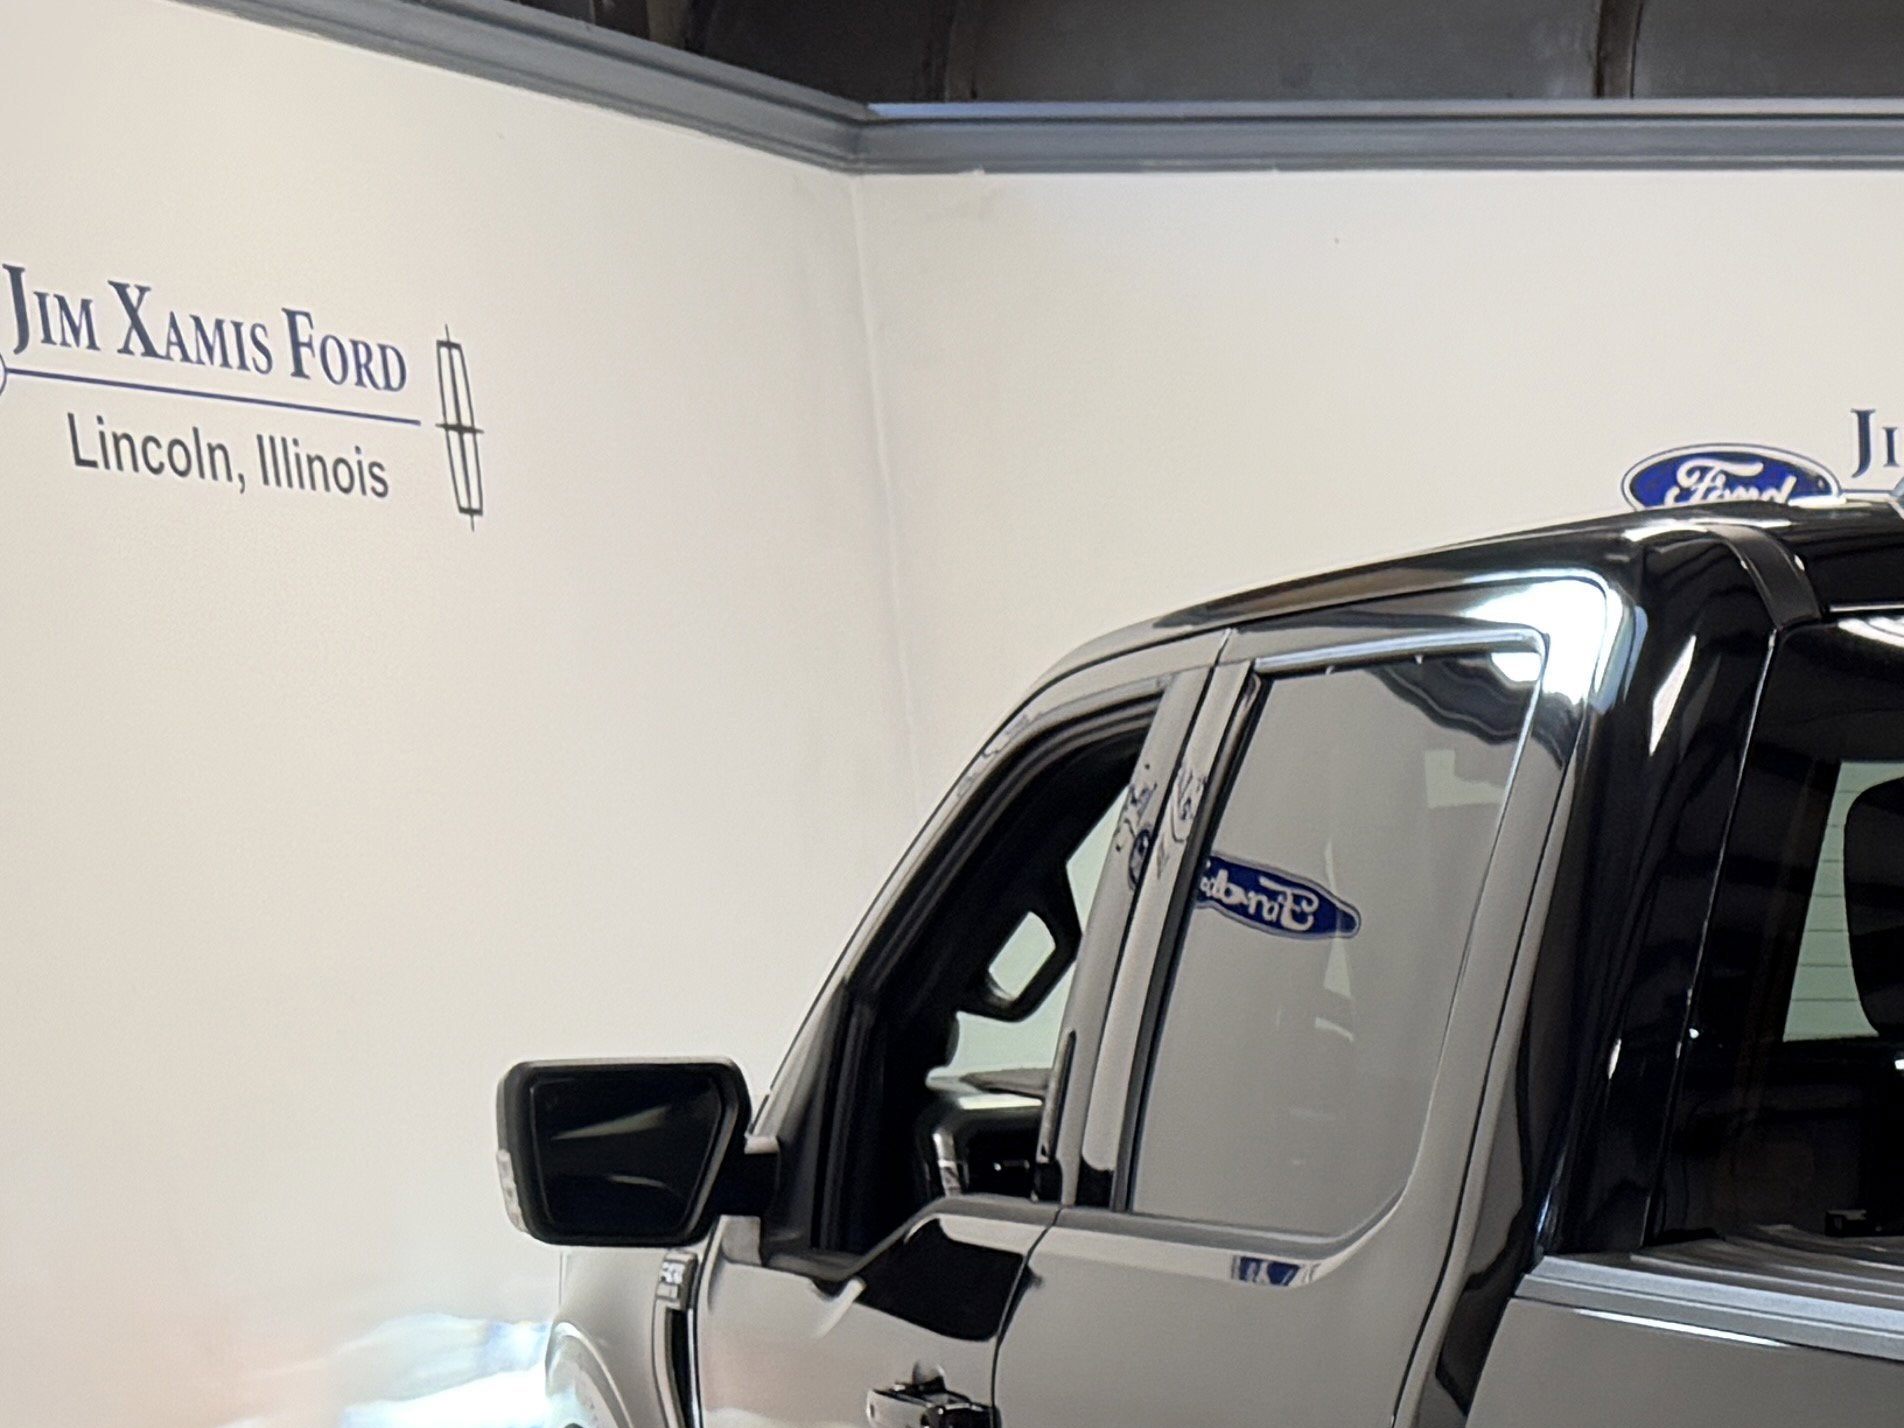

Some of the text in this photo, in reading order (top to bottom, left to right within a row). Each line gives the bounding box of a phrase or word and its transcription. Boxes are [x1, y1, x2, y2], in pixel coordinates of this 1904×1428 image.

[3, 264, 407, 392] JIM XAMIS FORD
[67, 412, 389, 498] Lincoln, Illinois
